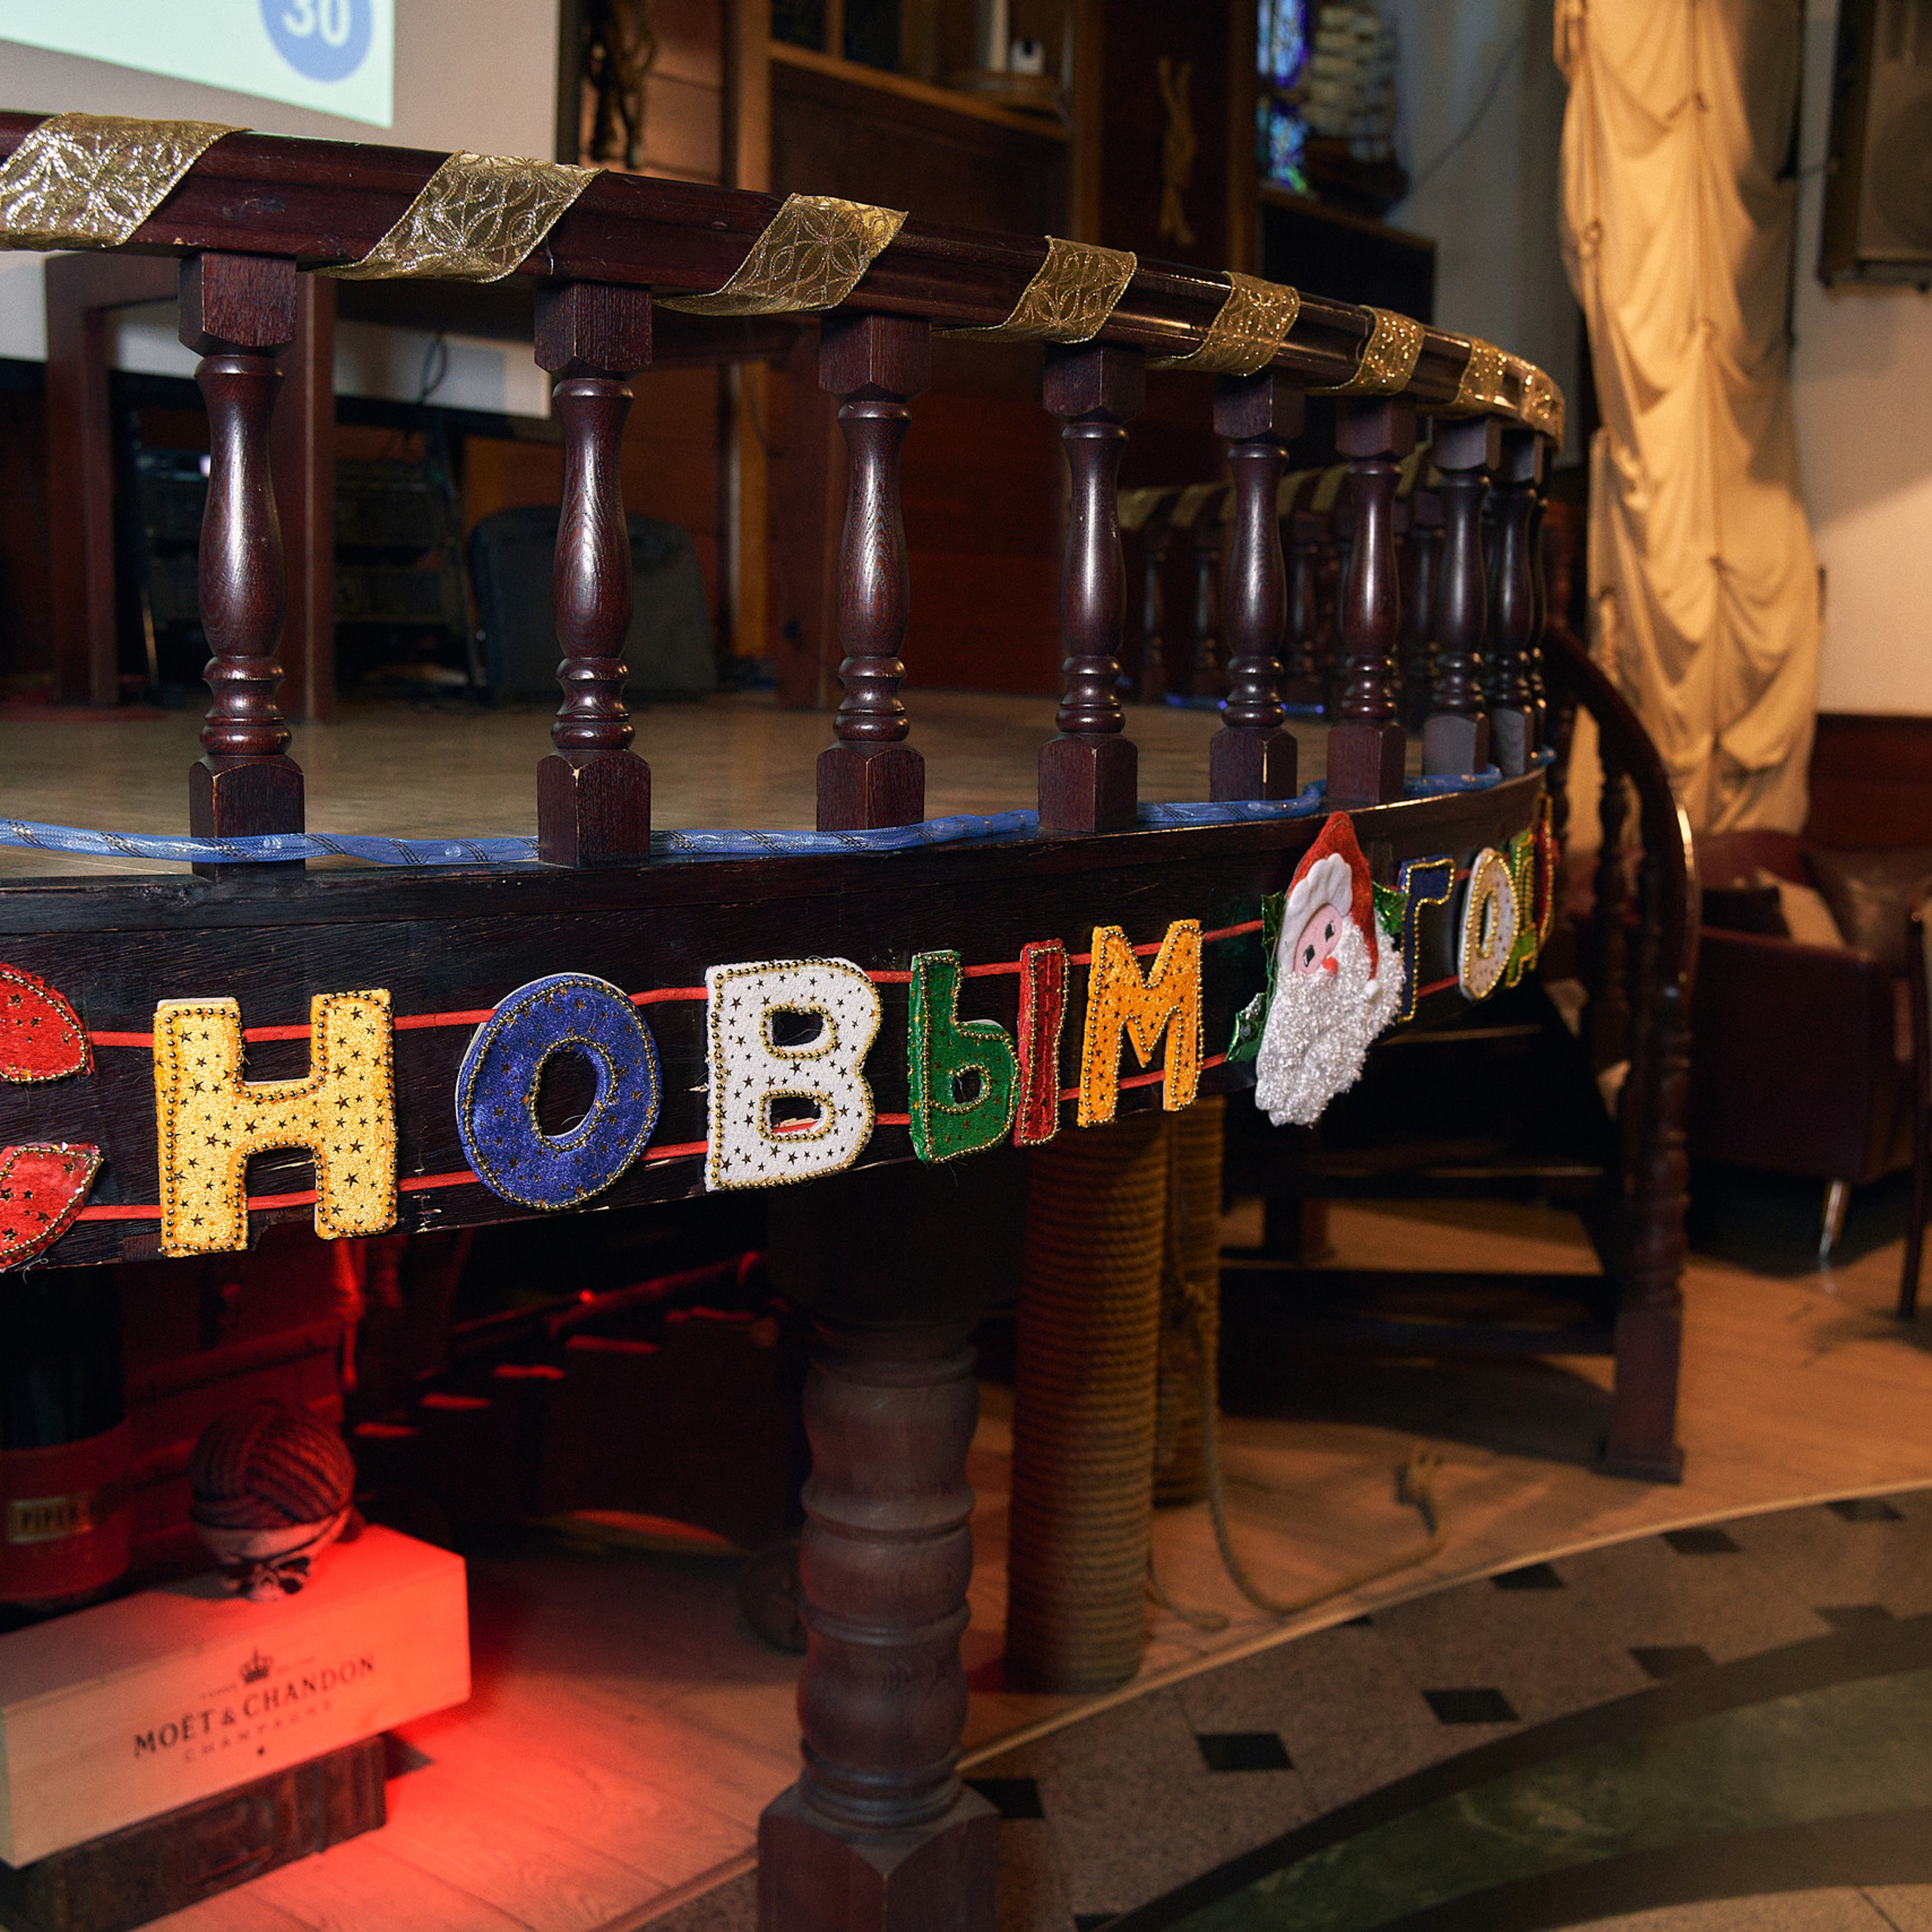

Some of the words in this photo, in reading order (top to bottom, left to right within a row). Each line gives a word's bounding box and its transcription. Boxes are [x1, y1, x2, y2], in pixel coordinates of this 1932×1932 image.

[282, 0, 350, 46] 30
[152, 918, 1205, 1258] НОВЫМ
[221, 1706, 237, 1726] &
[242, 1654, 377, 1716] CHANDON
